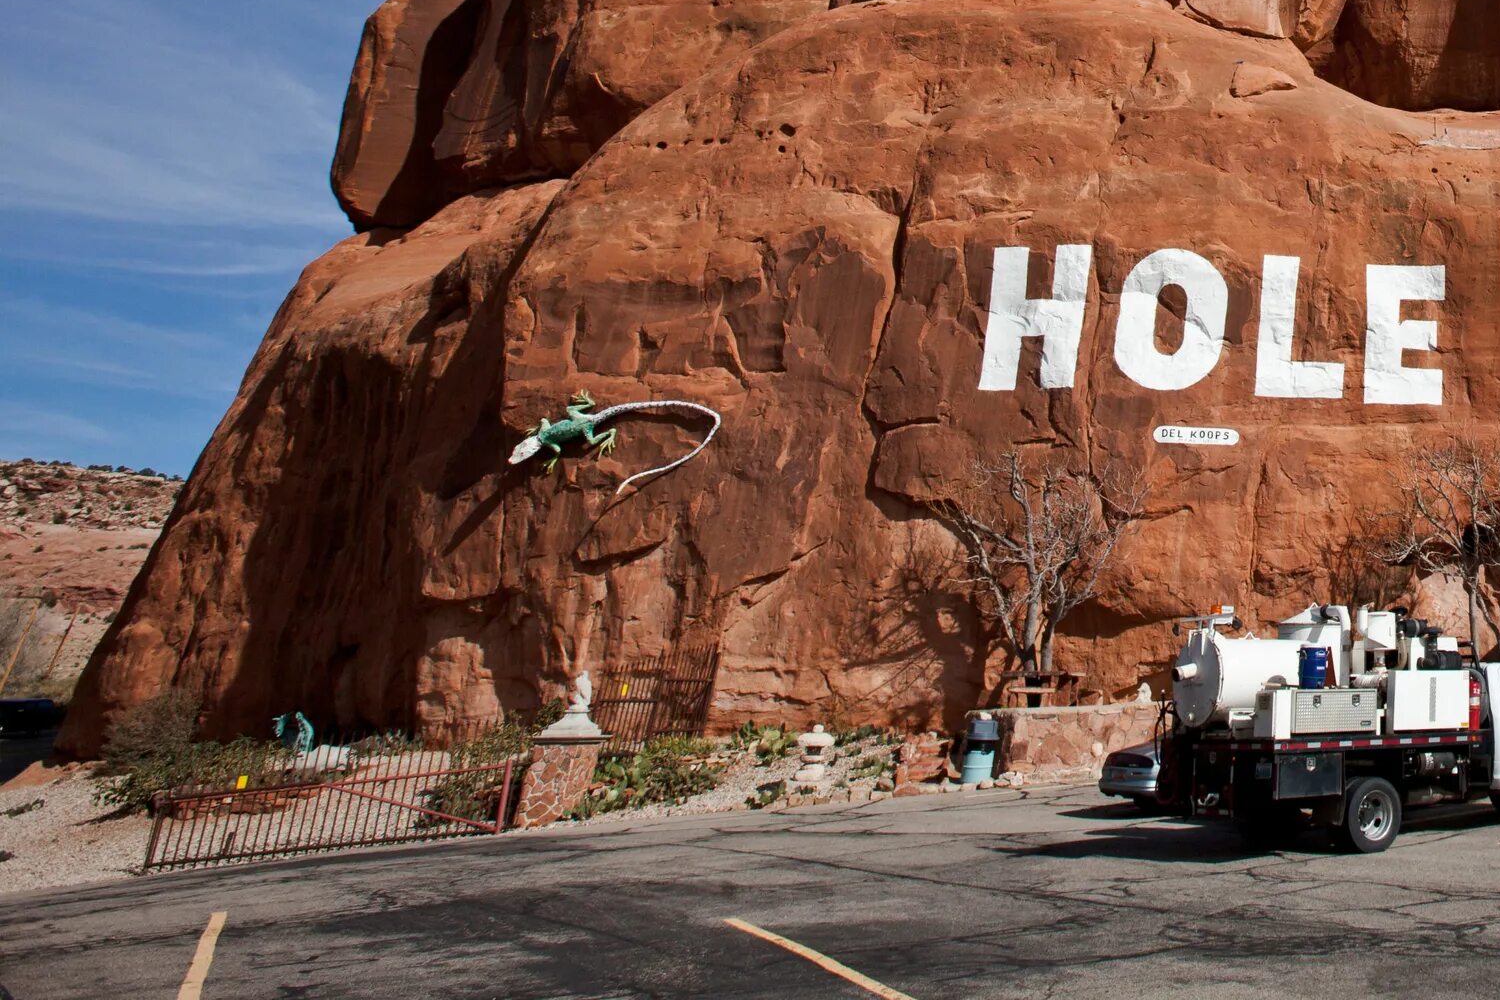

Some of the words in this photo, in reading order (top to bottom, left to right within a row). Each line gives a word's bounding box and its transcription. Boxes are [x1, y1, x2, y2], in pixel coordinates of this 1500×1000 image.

[978, 244, 1447, 405] HOLE
[1161, 428, 1183, 438] DEL
[1190, 430, 1230, 440] KOOPS
